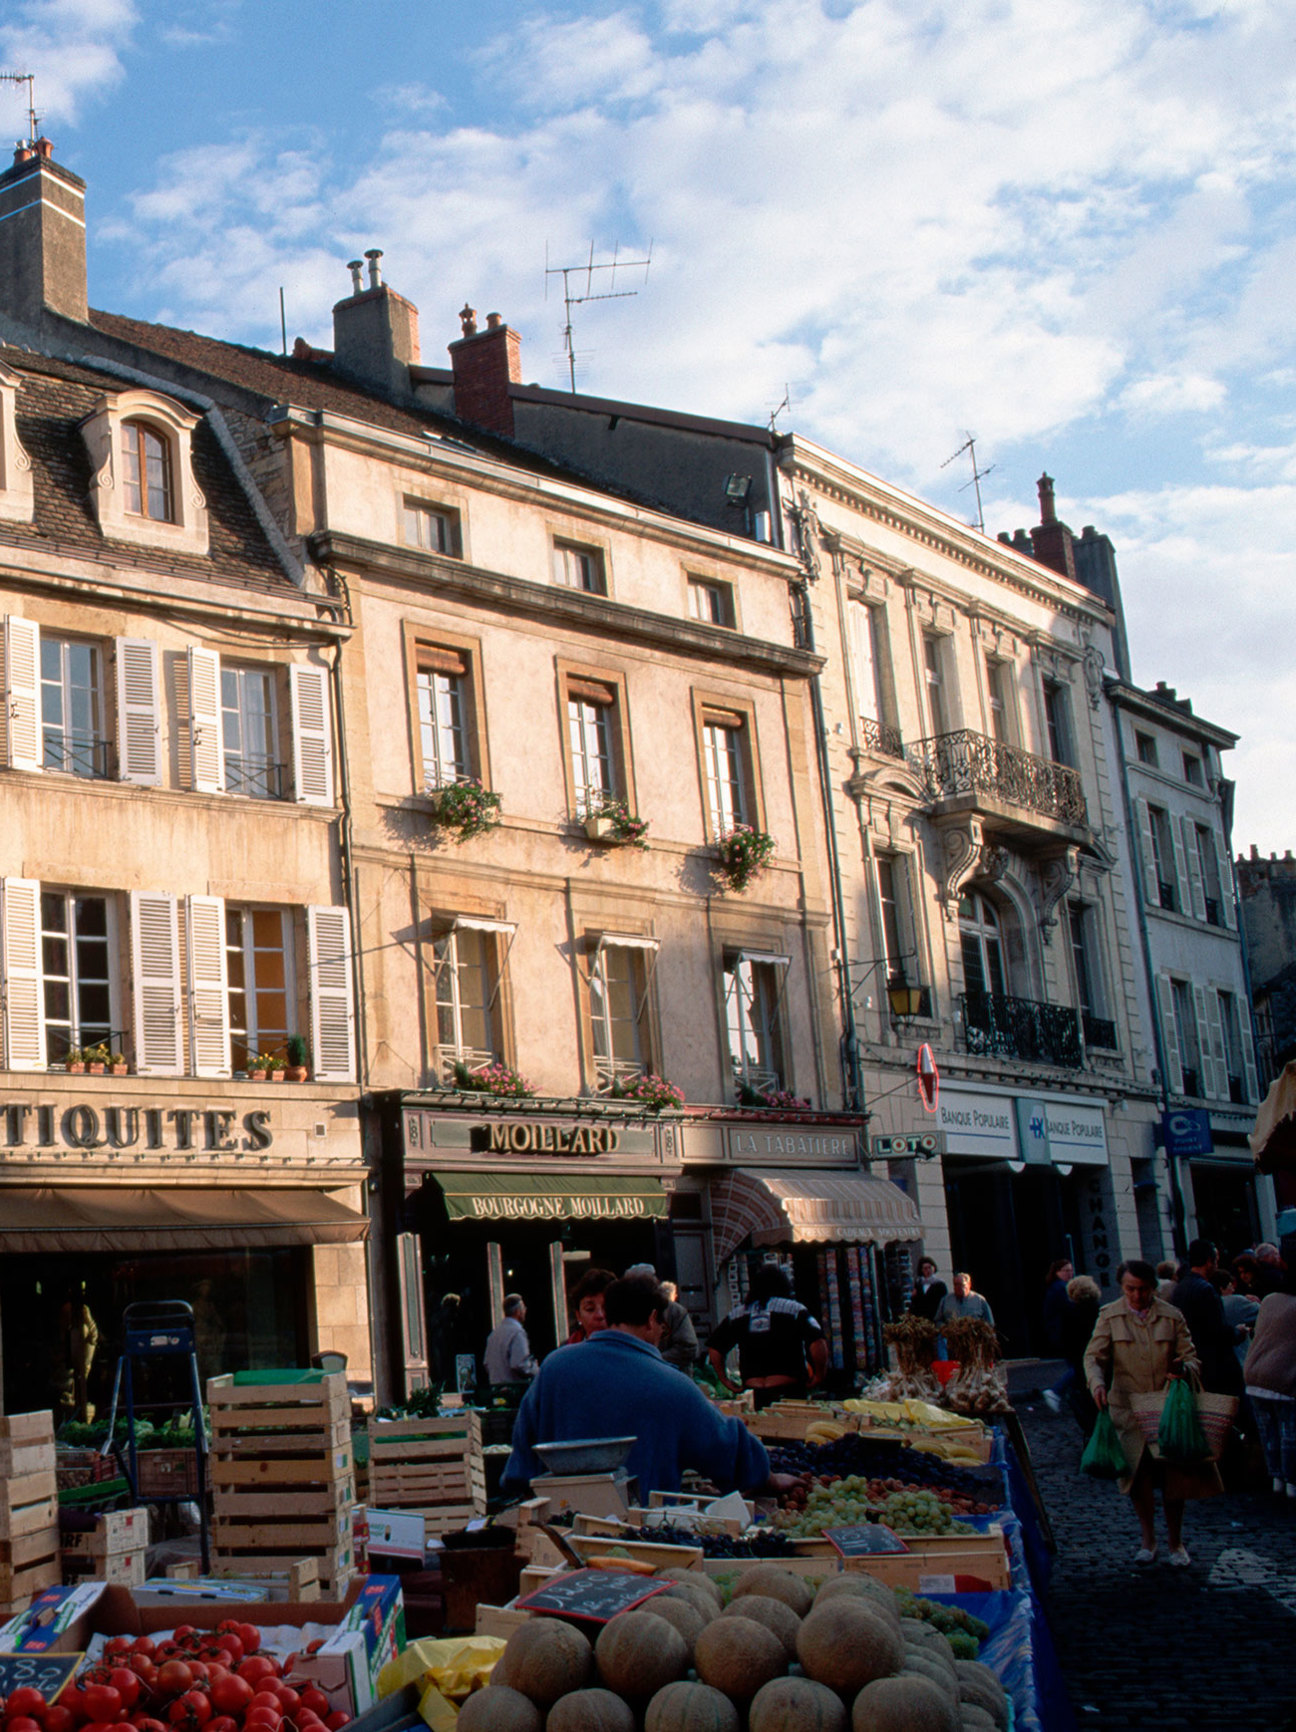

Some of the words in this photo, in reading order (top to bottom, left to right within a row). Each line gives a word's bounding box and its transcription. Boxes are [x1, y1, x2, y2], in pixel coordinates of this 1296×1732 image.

[940, 1106, 971, 1126] BANQUE
[973, 1109, 1010, 1130] POPULAIRE
[1047, 1119, 1070, 1136] ANQUE
[1071, 1119, 1103, 1138] POPULAIRE
[489, 1123, 620, 1153] MOILLARD
[736, 1134, 759, 1153] LA
[764, 1135, 850, 1156] TABATIERE
[876, 1134, 937, 1154] LOTO
[471, 1196, 565, 1217] BOURGOGNE
[570, 1197, 645, 1216] MOILLARD
[836, 1226, 874, 1238] CADEAUX
[1089, 1179, 1110, 1288] CHANGE
